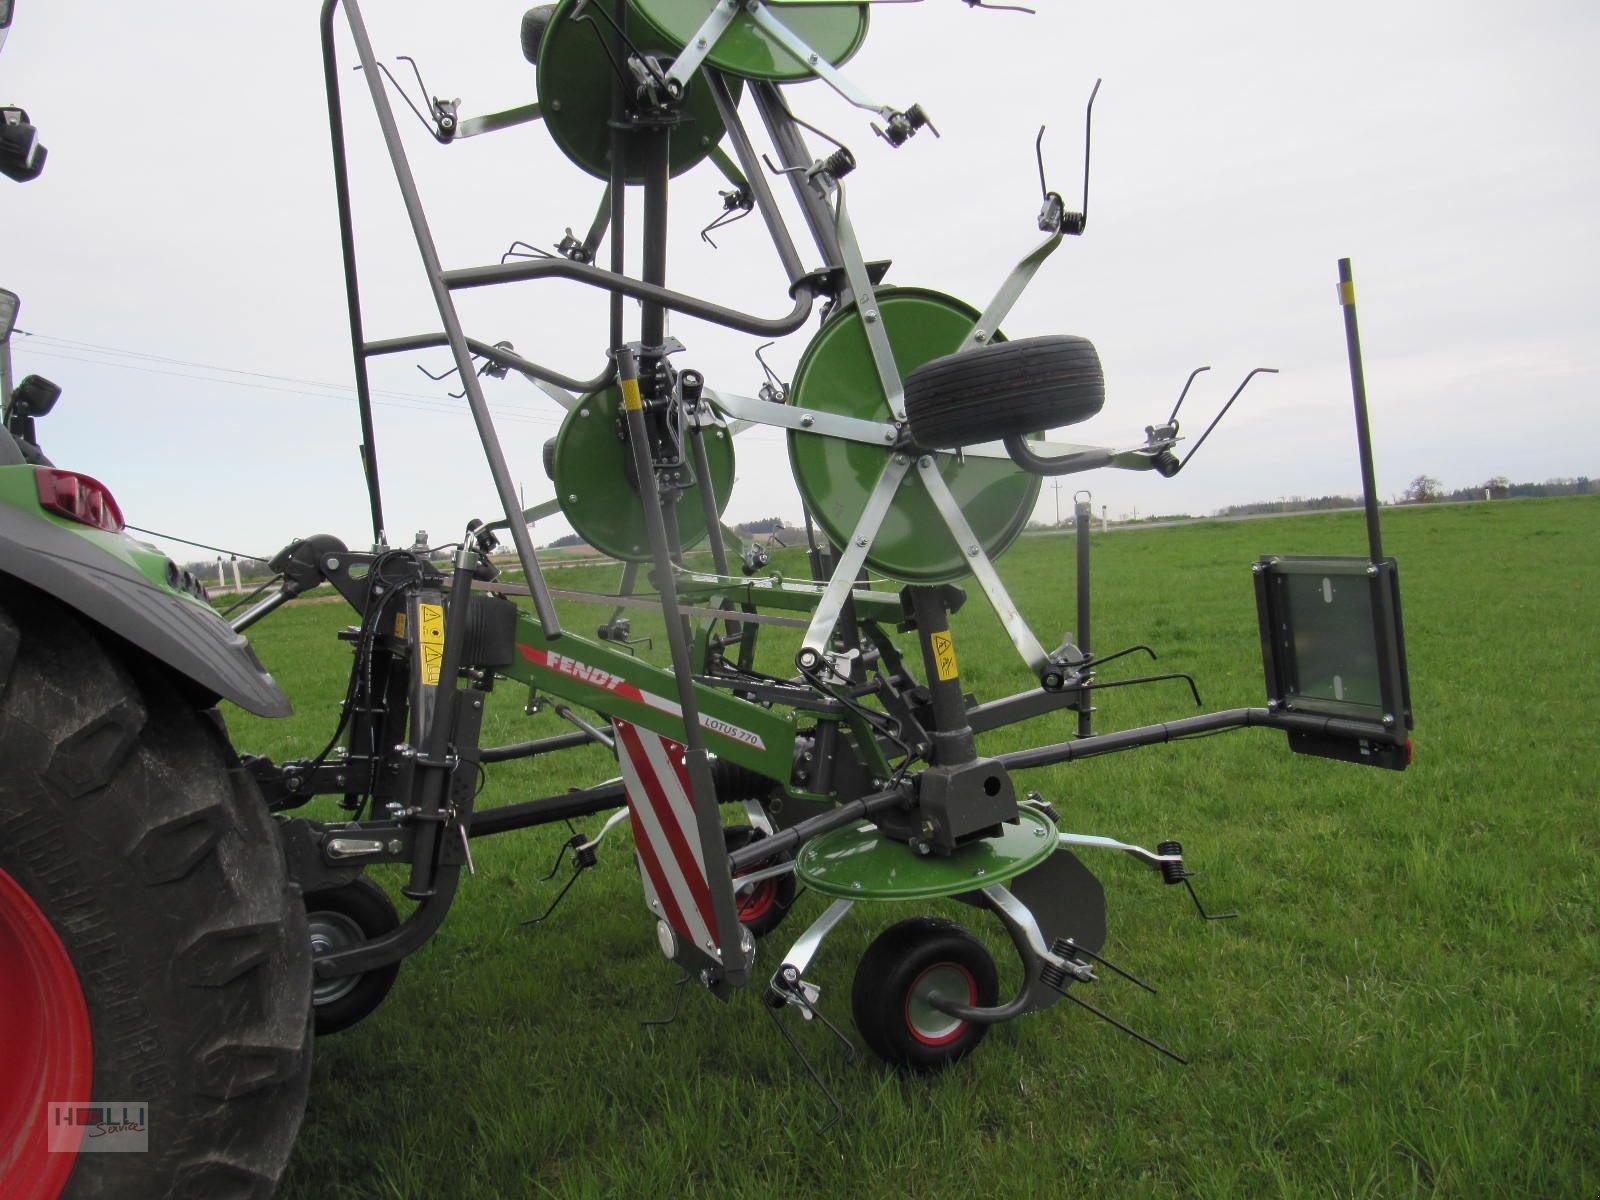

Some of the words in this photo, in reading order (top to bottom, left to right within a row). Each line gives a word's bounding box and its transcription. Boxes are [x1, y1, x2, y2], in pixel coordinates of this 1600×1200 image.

[547, 650, 625, 690] FENDT
[705, 717, 738, 737] LOTUS
[739, 730, 758, 745] 770
